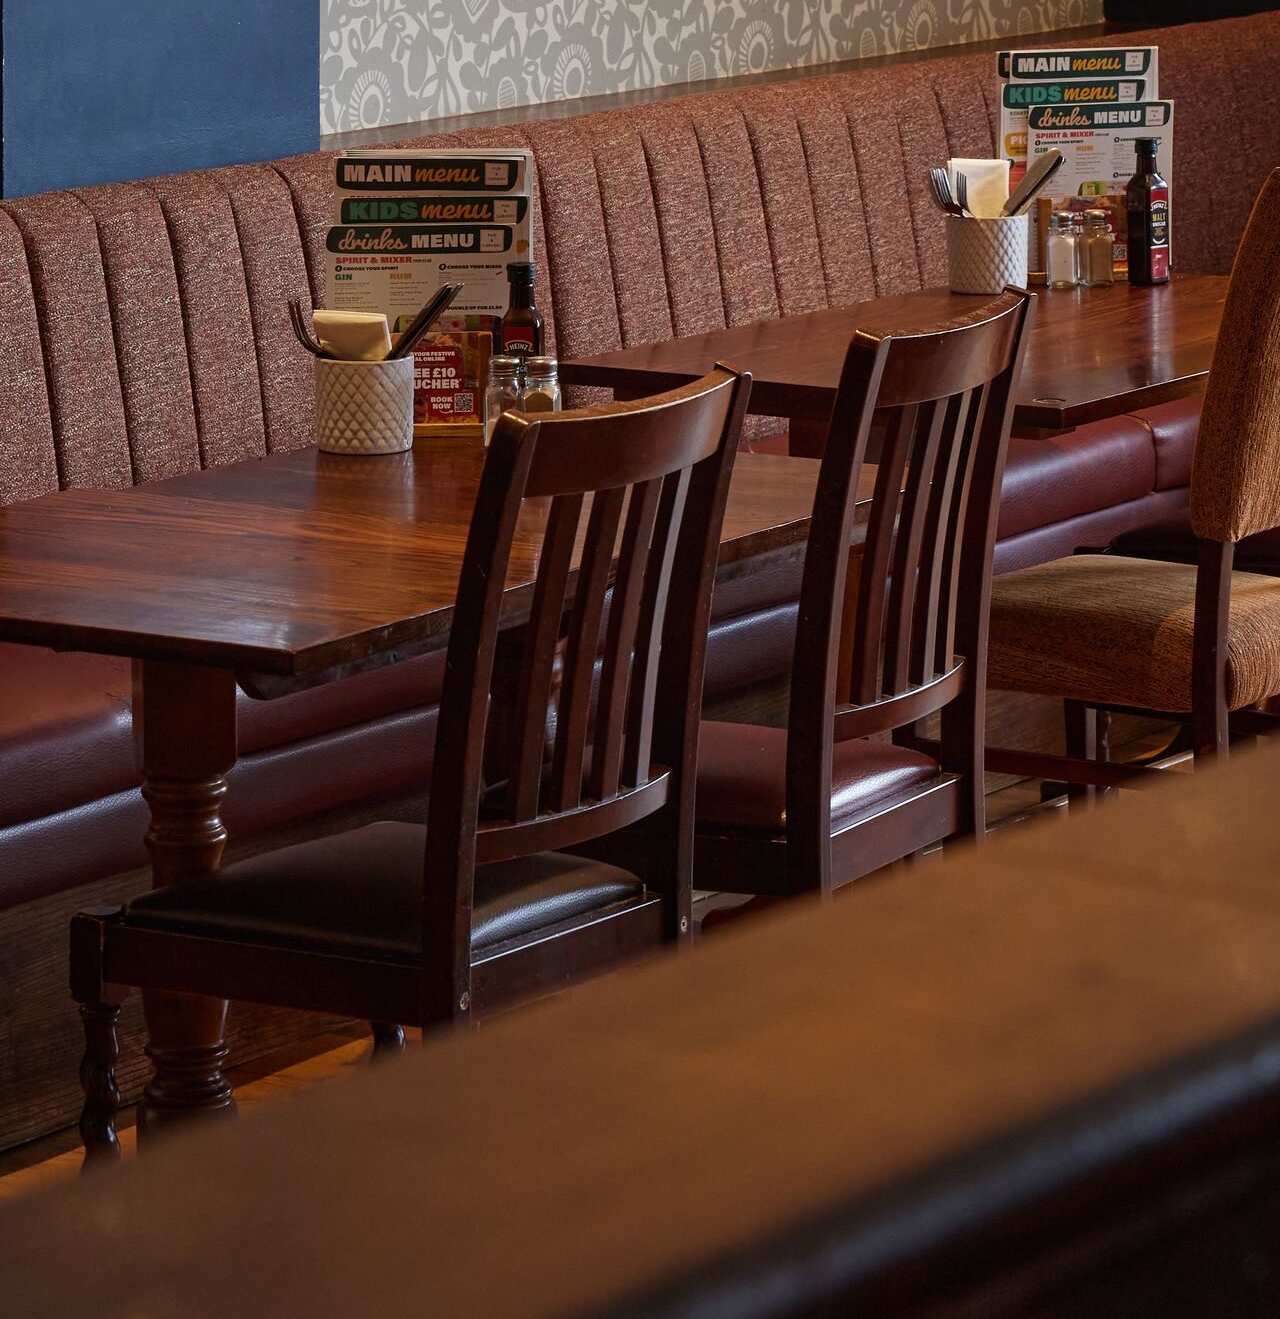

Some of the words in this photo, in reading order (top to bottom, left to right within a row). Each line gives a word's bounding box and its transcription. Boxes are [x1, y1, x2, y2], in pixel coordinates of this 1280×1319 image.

[1017, 56, 1070, 73] MAIN
[1072, 56, 1122, 72] menu
[1010, 85, 1062, 103] KIDS
[1064, 86, 1117, 101] menu
[1038, 106, 1091, 128] drinks
[1094, 110, 1141, 124] MENU
[343, 164, 412, 182] MAIN
[415, 165, 479, 183] menu
[349, 201, 420, 220] KIDS
[421, 202, 492, 220] menu
[338, 228, 408, 251] drinks
[411, 233, 474, 248] MENU
[414, 368, 430, 378] EE
[432, 367, 456, 378] £10
